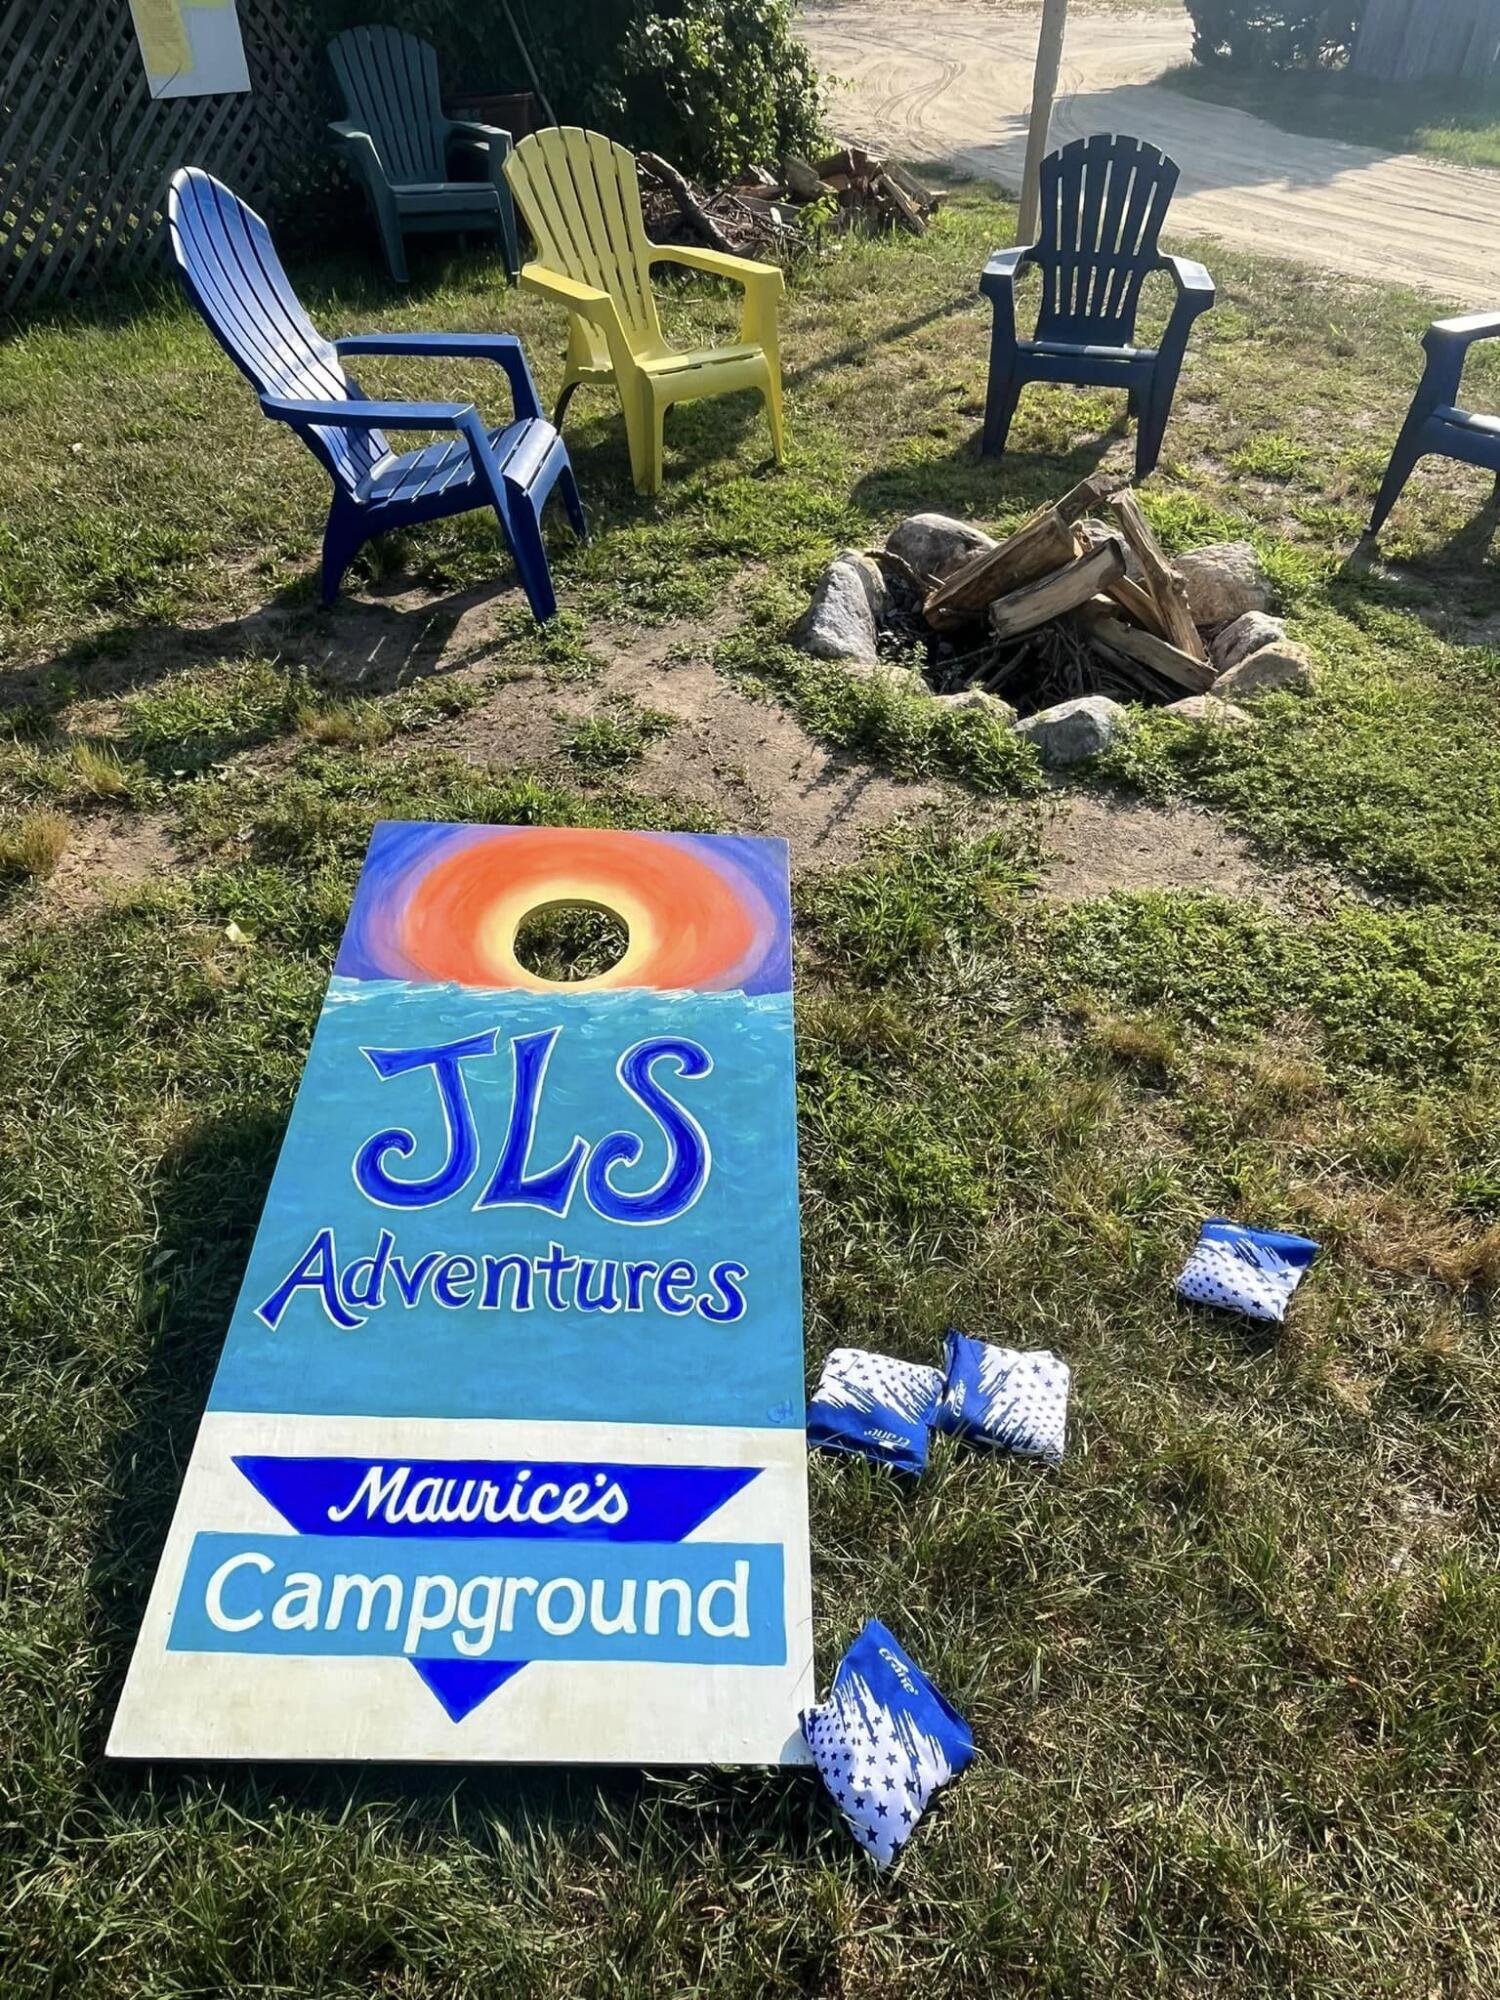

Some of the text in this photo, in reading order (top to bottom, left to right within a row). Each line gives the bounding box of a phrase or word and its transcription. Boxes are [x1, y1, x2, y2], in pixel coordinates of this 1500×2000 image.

[352, 1025, 714, 1226] JLS
[253, 1228, 749, 1331] Adventures
[327, 1466, 629, 1525] Maurice's
[204, 1552, 750, 1656] Campground
[879, 1648, 916, 1694] crane
